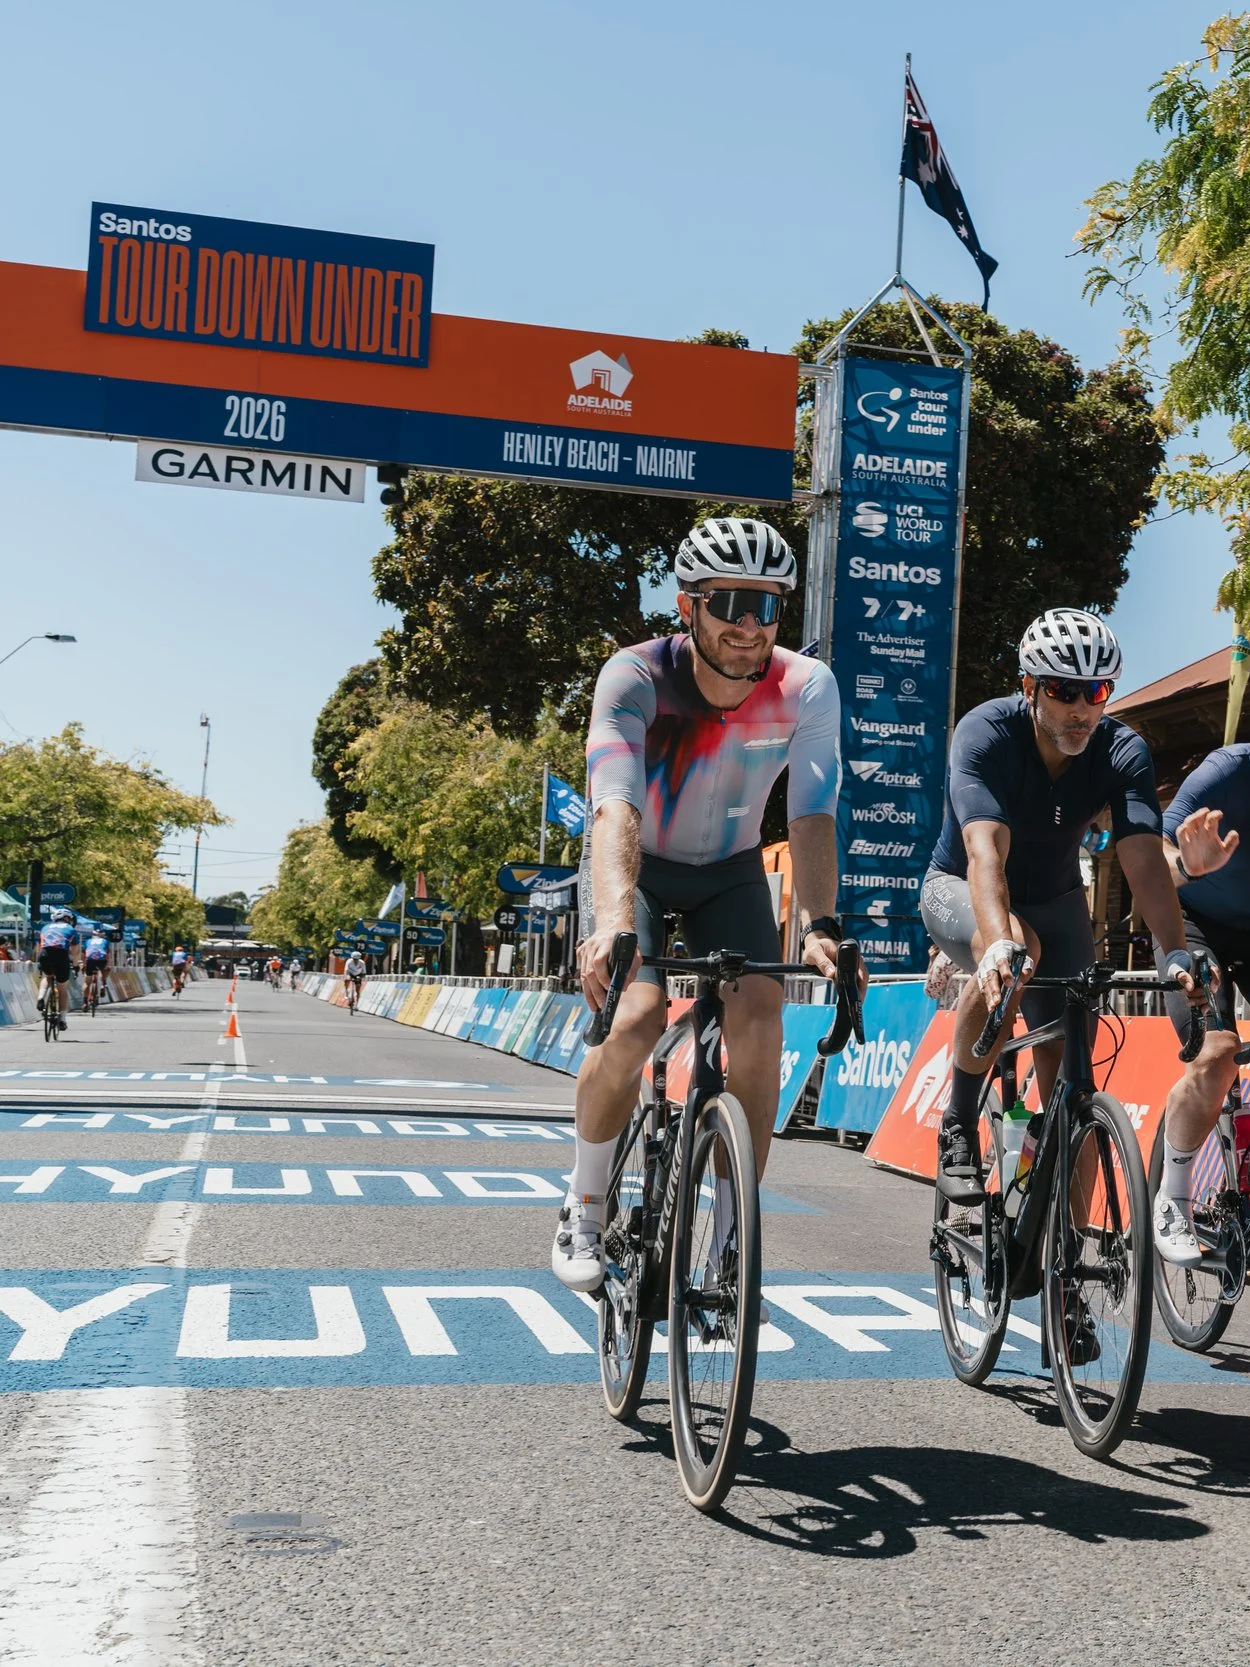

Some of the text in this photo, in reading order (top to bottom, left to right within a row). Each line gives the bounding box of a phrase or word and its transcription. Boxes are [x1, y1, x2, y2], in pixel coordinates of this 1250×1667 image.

[99, 212, 192, 242] Santos
[98, 235, 423, 359] TOUR DOWN UNDER
[910, 388, 949, 401] Santos
[567, 394, 632, 411] ADELAIDE
[918, 401, 947, 413] tour
[224, 395, 287, 442] 2026
[593, 408, 632, 417] AUSTRALIA
[911, 410, 947, 424] down
[907, 424, 947, 436] under
[503, 431, 564, 467] HENLEY
[567, 438, 620, 473] BEACH
[636, 445, 697, 481] NAIRNE
[151, 448, 352, 496] GARMIN
[853, 454, 947, 478] ADELAIDE
[852, 471, 947, 487] SOUTH AUSTRALIA
[896, 504, 923, 517] UCI
[896, 517, 943, 531] WORLD
[896, 529, 931, 543] TOUR
[849, 557, 941, 585] Santos
[857, 632, 925, 646] The Advertiser
[870, 645, 925, 658] Sunday Mail
[850, 717, 925, 737] Vanguard
[896, 740, 917, 748] Steady
[873, 771, 924, 787] Ziptrak
[852, 808, 916, 824] WHOOSH
[848, 840, 916, 857] Santini
[841, 874, 919, 889] SHIMANO
[500, 912, 516, 924] 25
[406, 930, 418, 940] 50
[859, 940, 911, 955] YAMAHA
[838, 1029, 912, 1089] Santos
